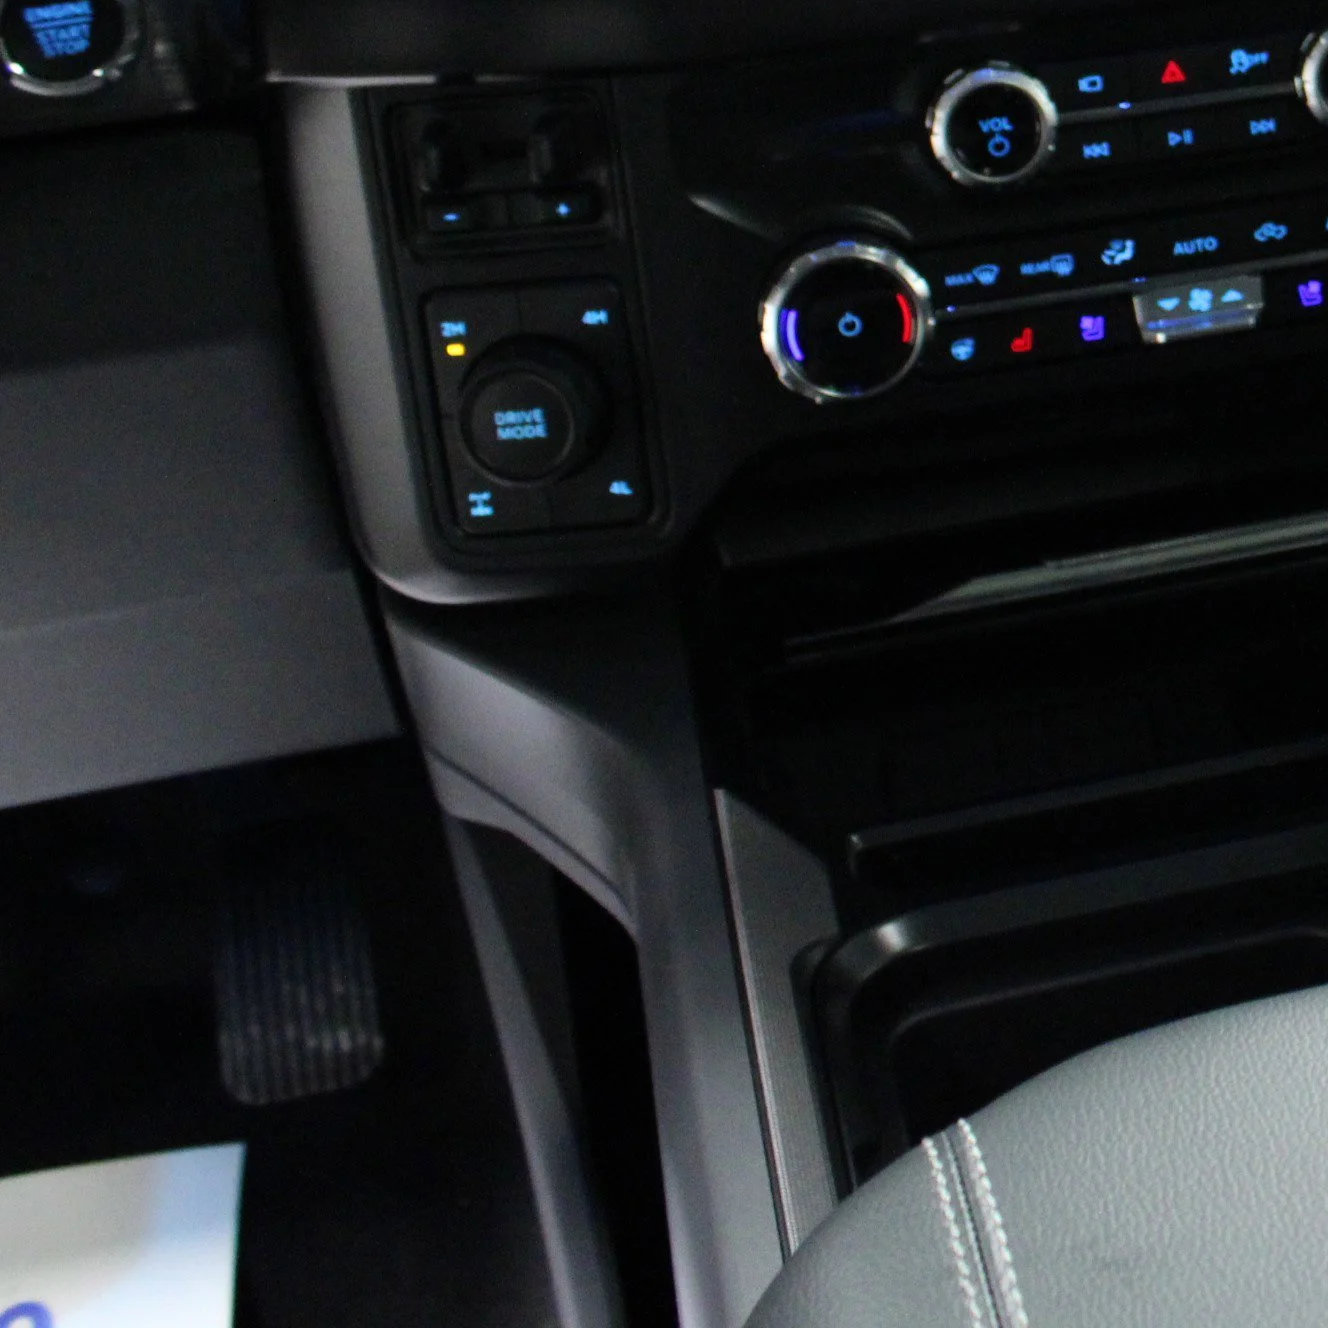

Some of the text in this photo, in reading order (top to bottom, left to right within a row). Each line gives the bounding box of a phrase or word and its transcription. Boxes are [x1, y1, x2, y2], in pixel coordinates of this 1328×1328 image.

[979, 116, 1014, 134] VOL
[1173, 236, 1219, 255] AUTO
[494, 408, 546, 426] DRIVE
[497, 422, 548, 440] MODE
